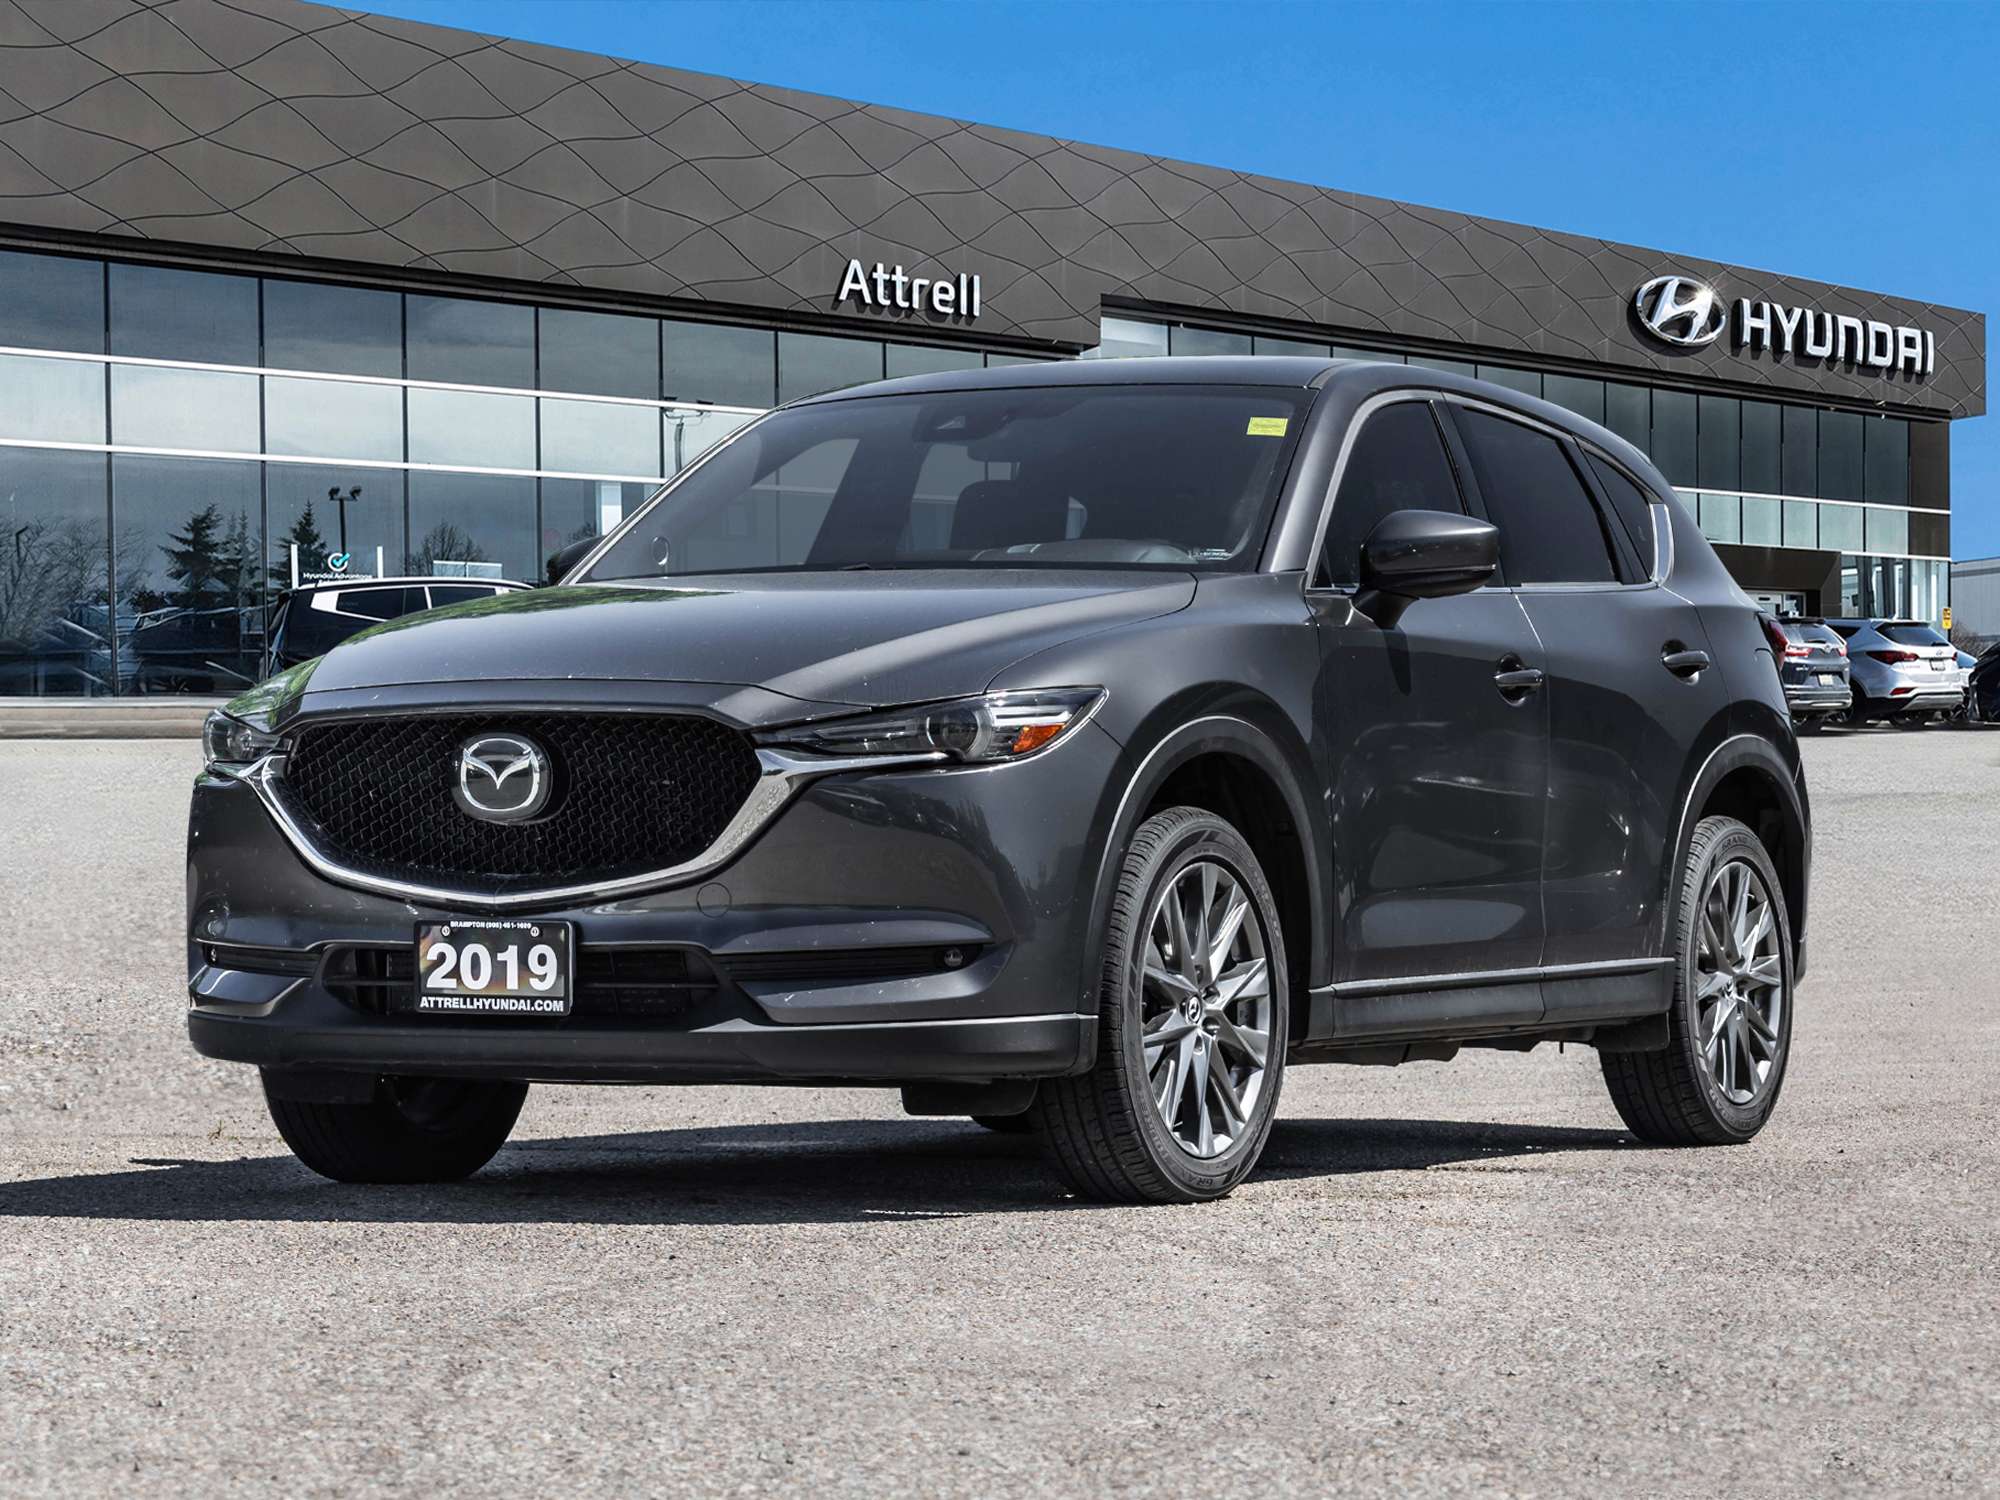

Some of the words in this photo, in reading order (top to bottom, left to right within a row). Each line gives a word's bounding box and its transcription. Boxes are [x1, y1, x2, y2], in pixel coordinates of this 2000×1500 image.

[838, 258, 980, 317] Attrell
[1740, 298, 1935, 376] HYUNDAI
[303, 572, 333, 580] Hyundai
[335, 572, 373, 581] Advantage
[450, 920, 485, 928] BRAMPTON
[426, 942, 558, 991] 2019
[420, 996, 564, 1012] ATTRELLHYUNDAI.COM
